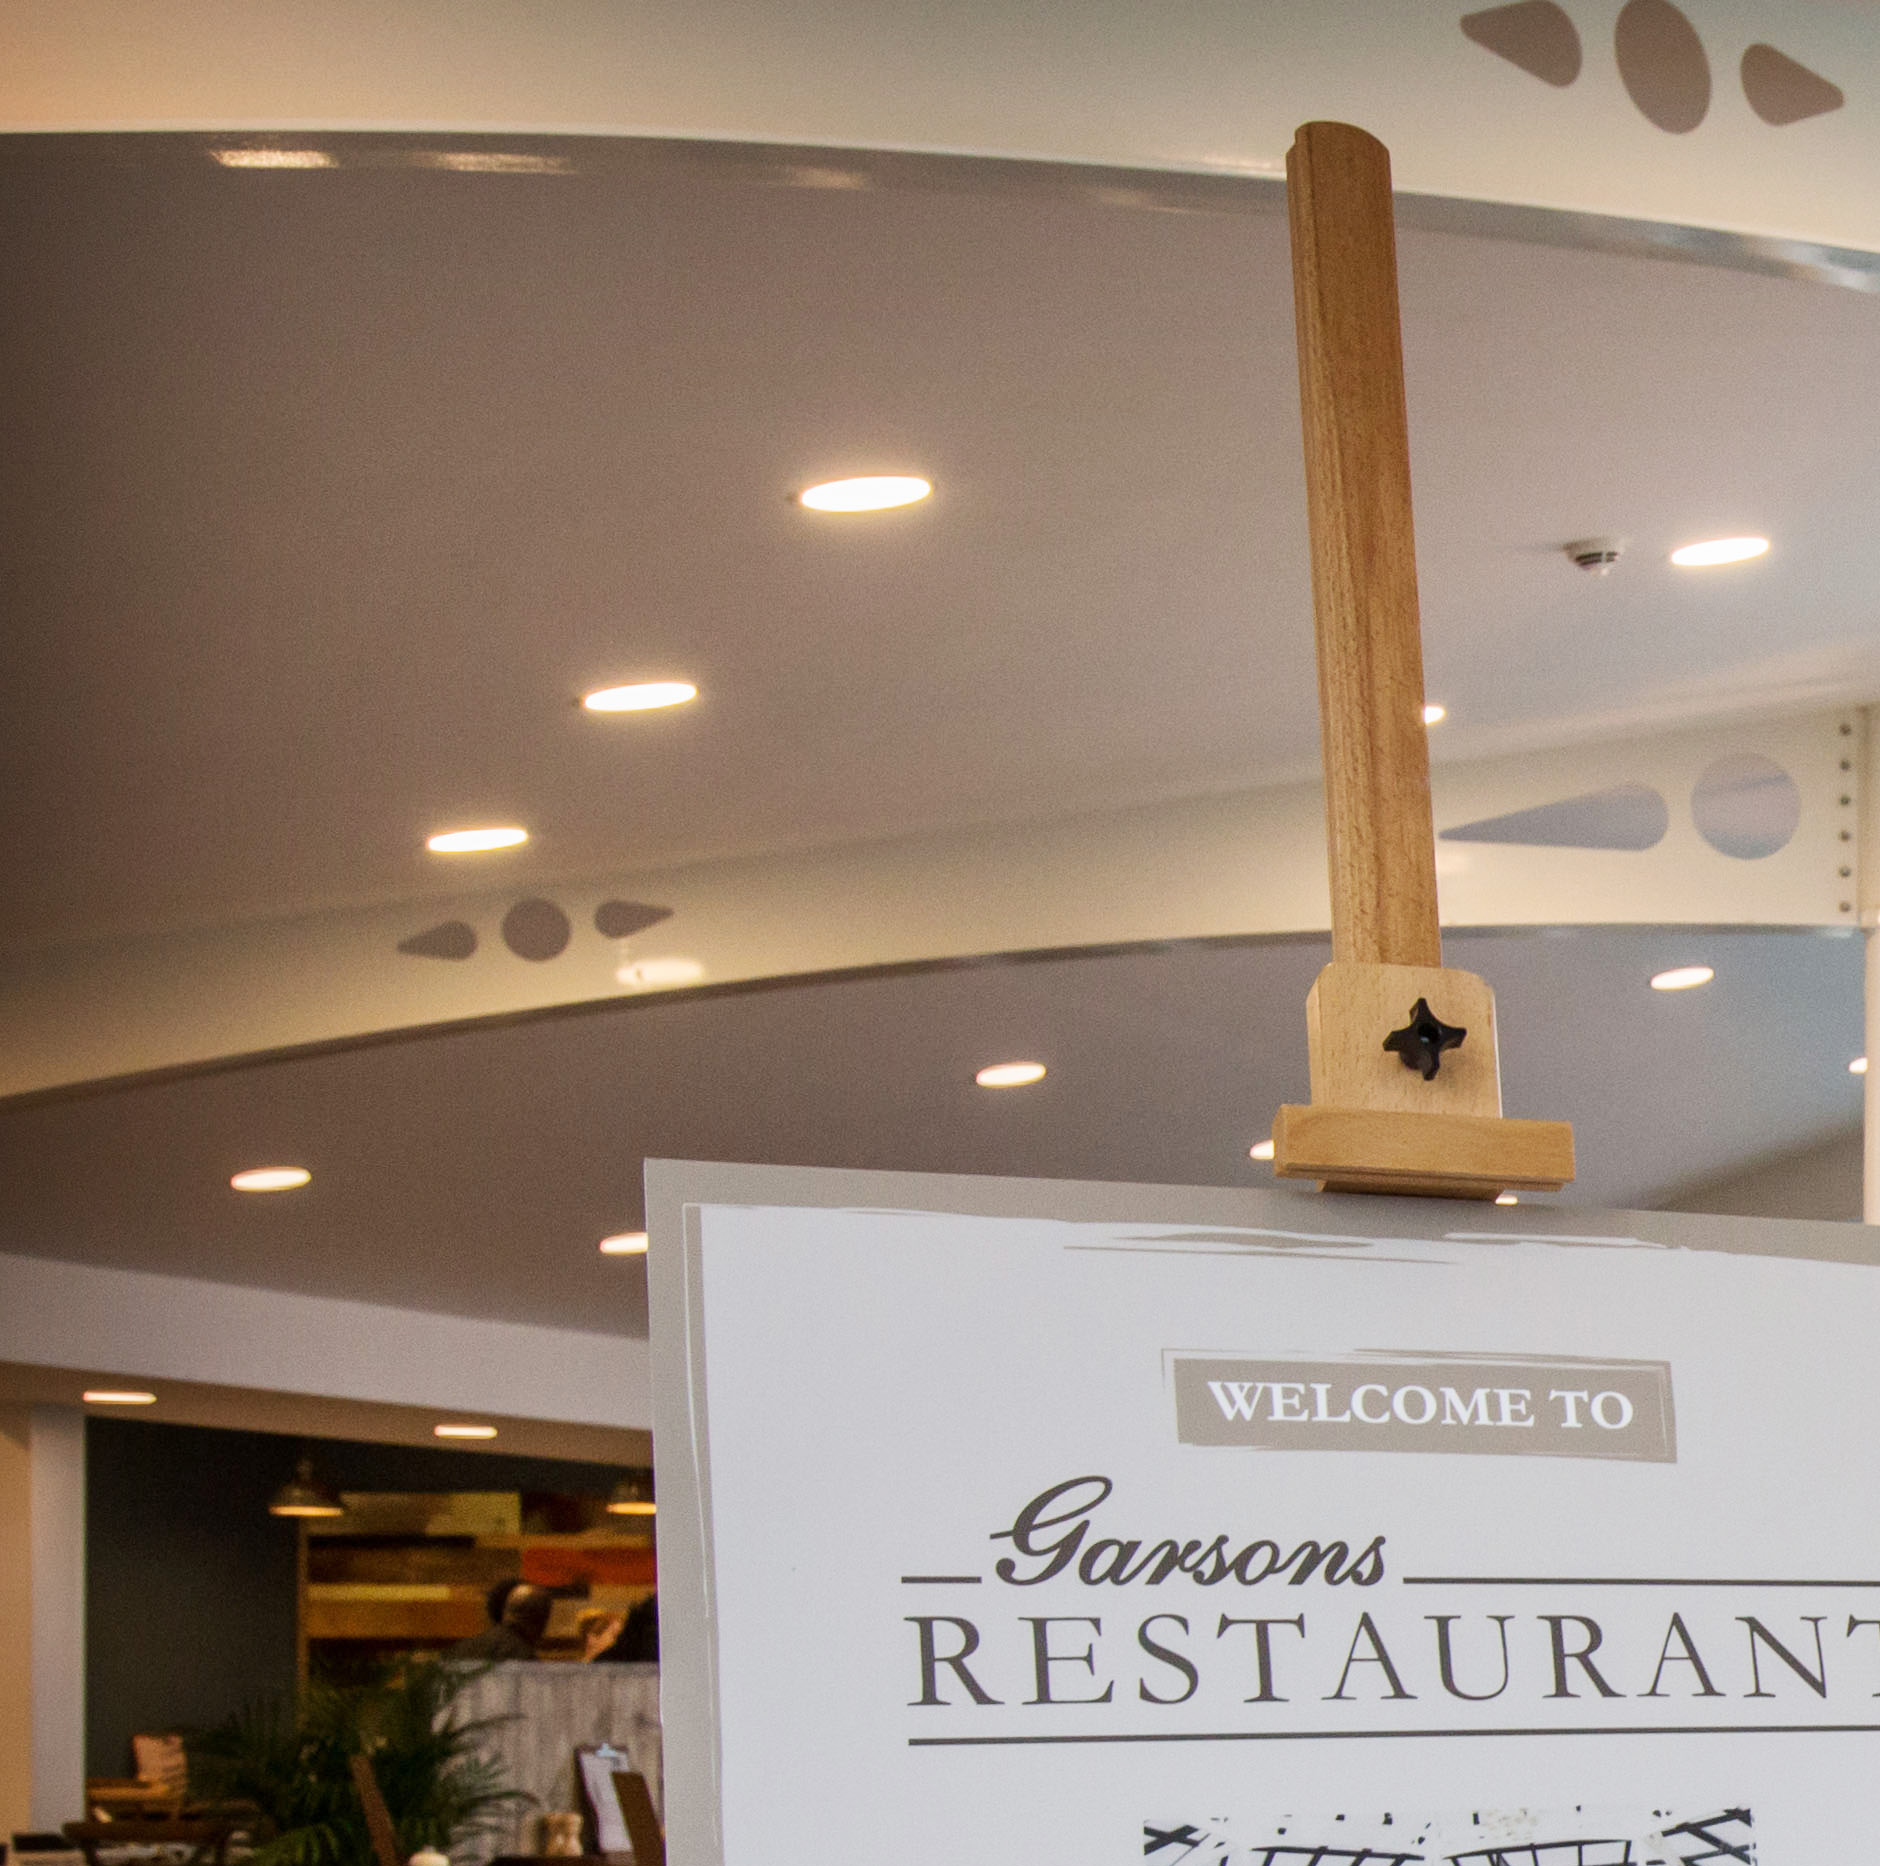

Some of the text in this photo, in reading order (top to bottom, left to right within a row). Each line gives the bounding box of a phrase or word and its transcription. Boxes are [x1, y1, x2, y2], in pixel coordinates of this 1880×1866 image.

[1208, 1382, 1633, 1428] WELCOME TO
[990, 1476, 1386, 1586] Garsons
